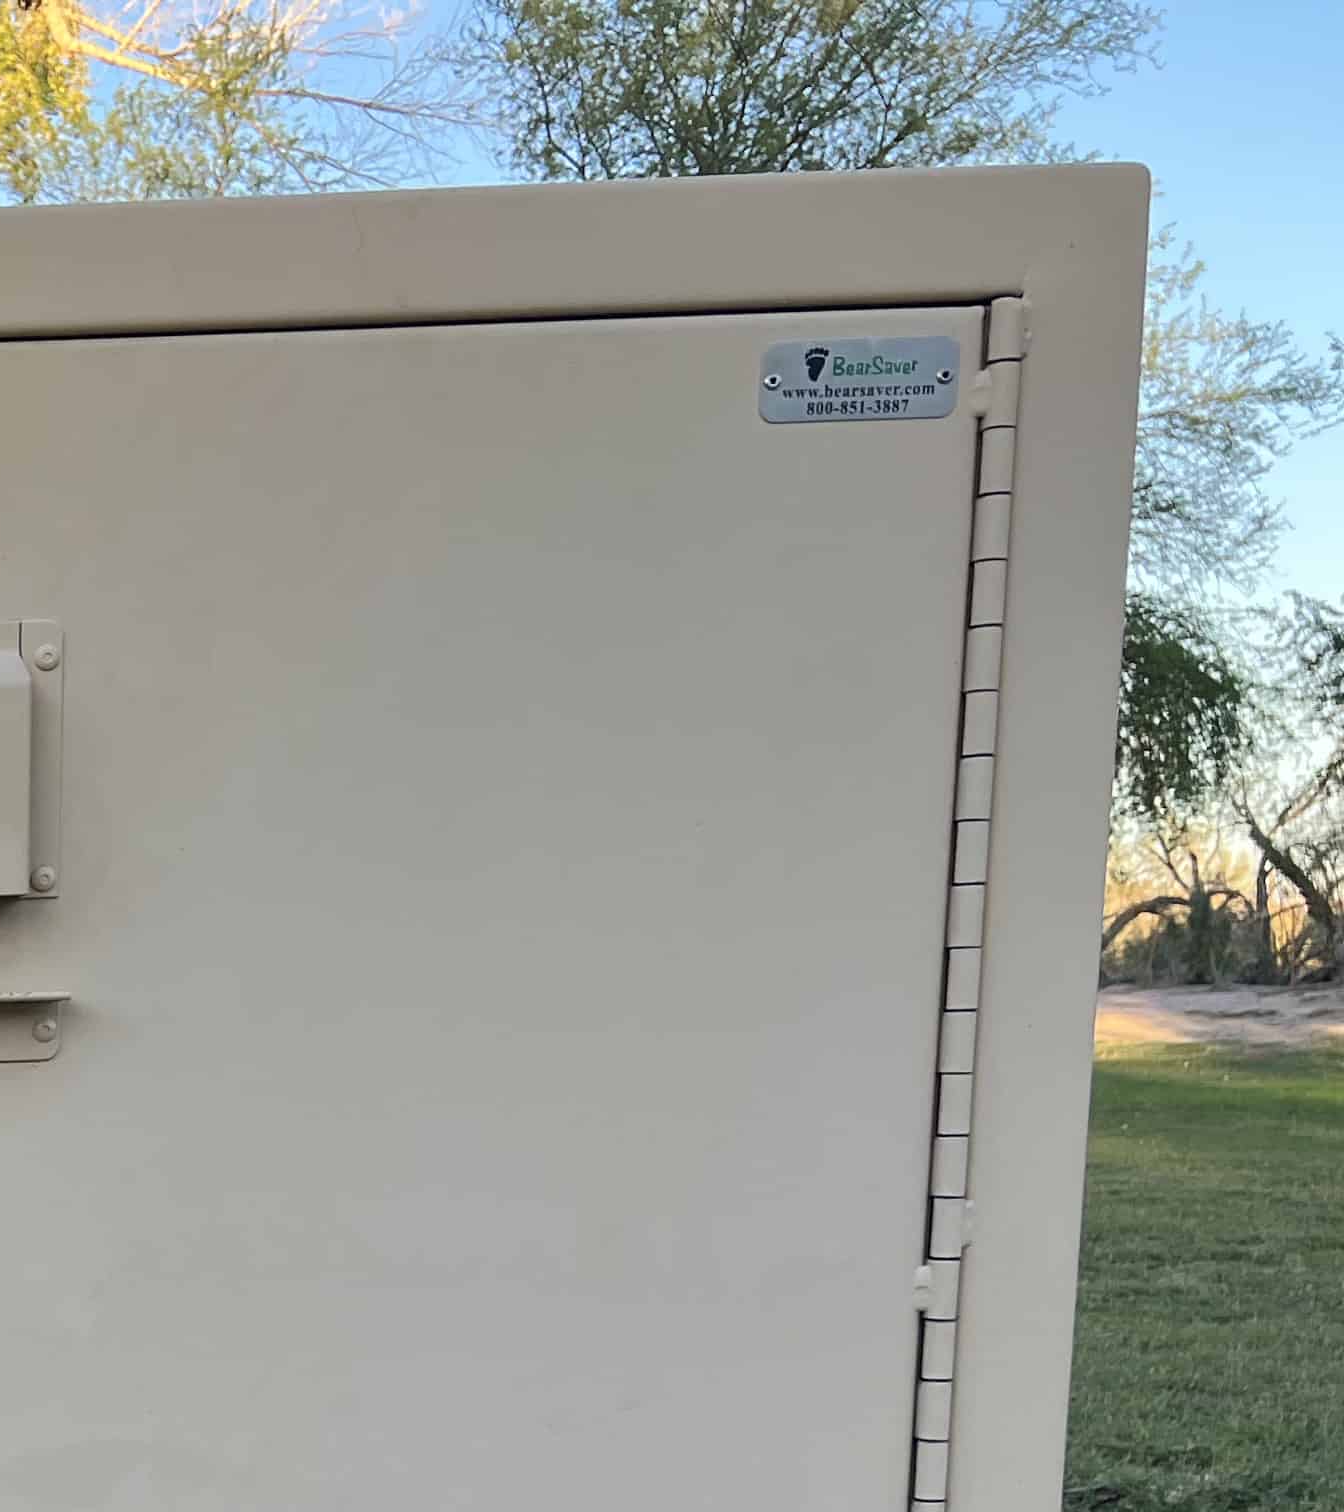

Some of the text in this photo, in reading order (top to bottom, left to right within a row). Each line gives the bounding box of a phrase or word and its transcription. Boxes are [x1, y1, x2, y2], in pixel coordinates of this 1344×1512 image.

[832, 355, 919, 377] BearSaver
[781, 383, 936, 400] www.bearsaver.com
[805, 399, 910, 416] 800-851-3887
